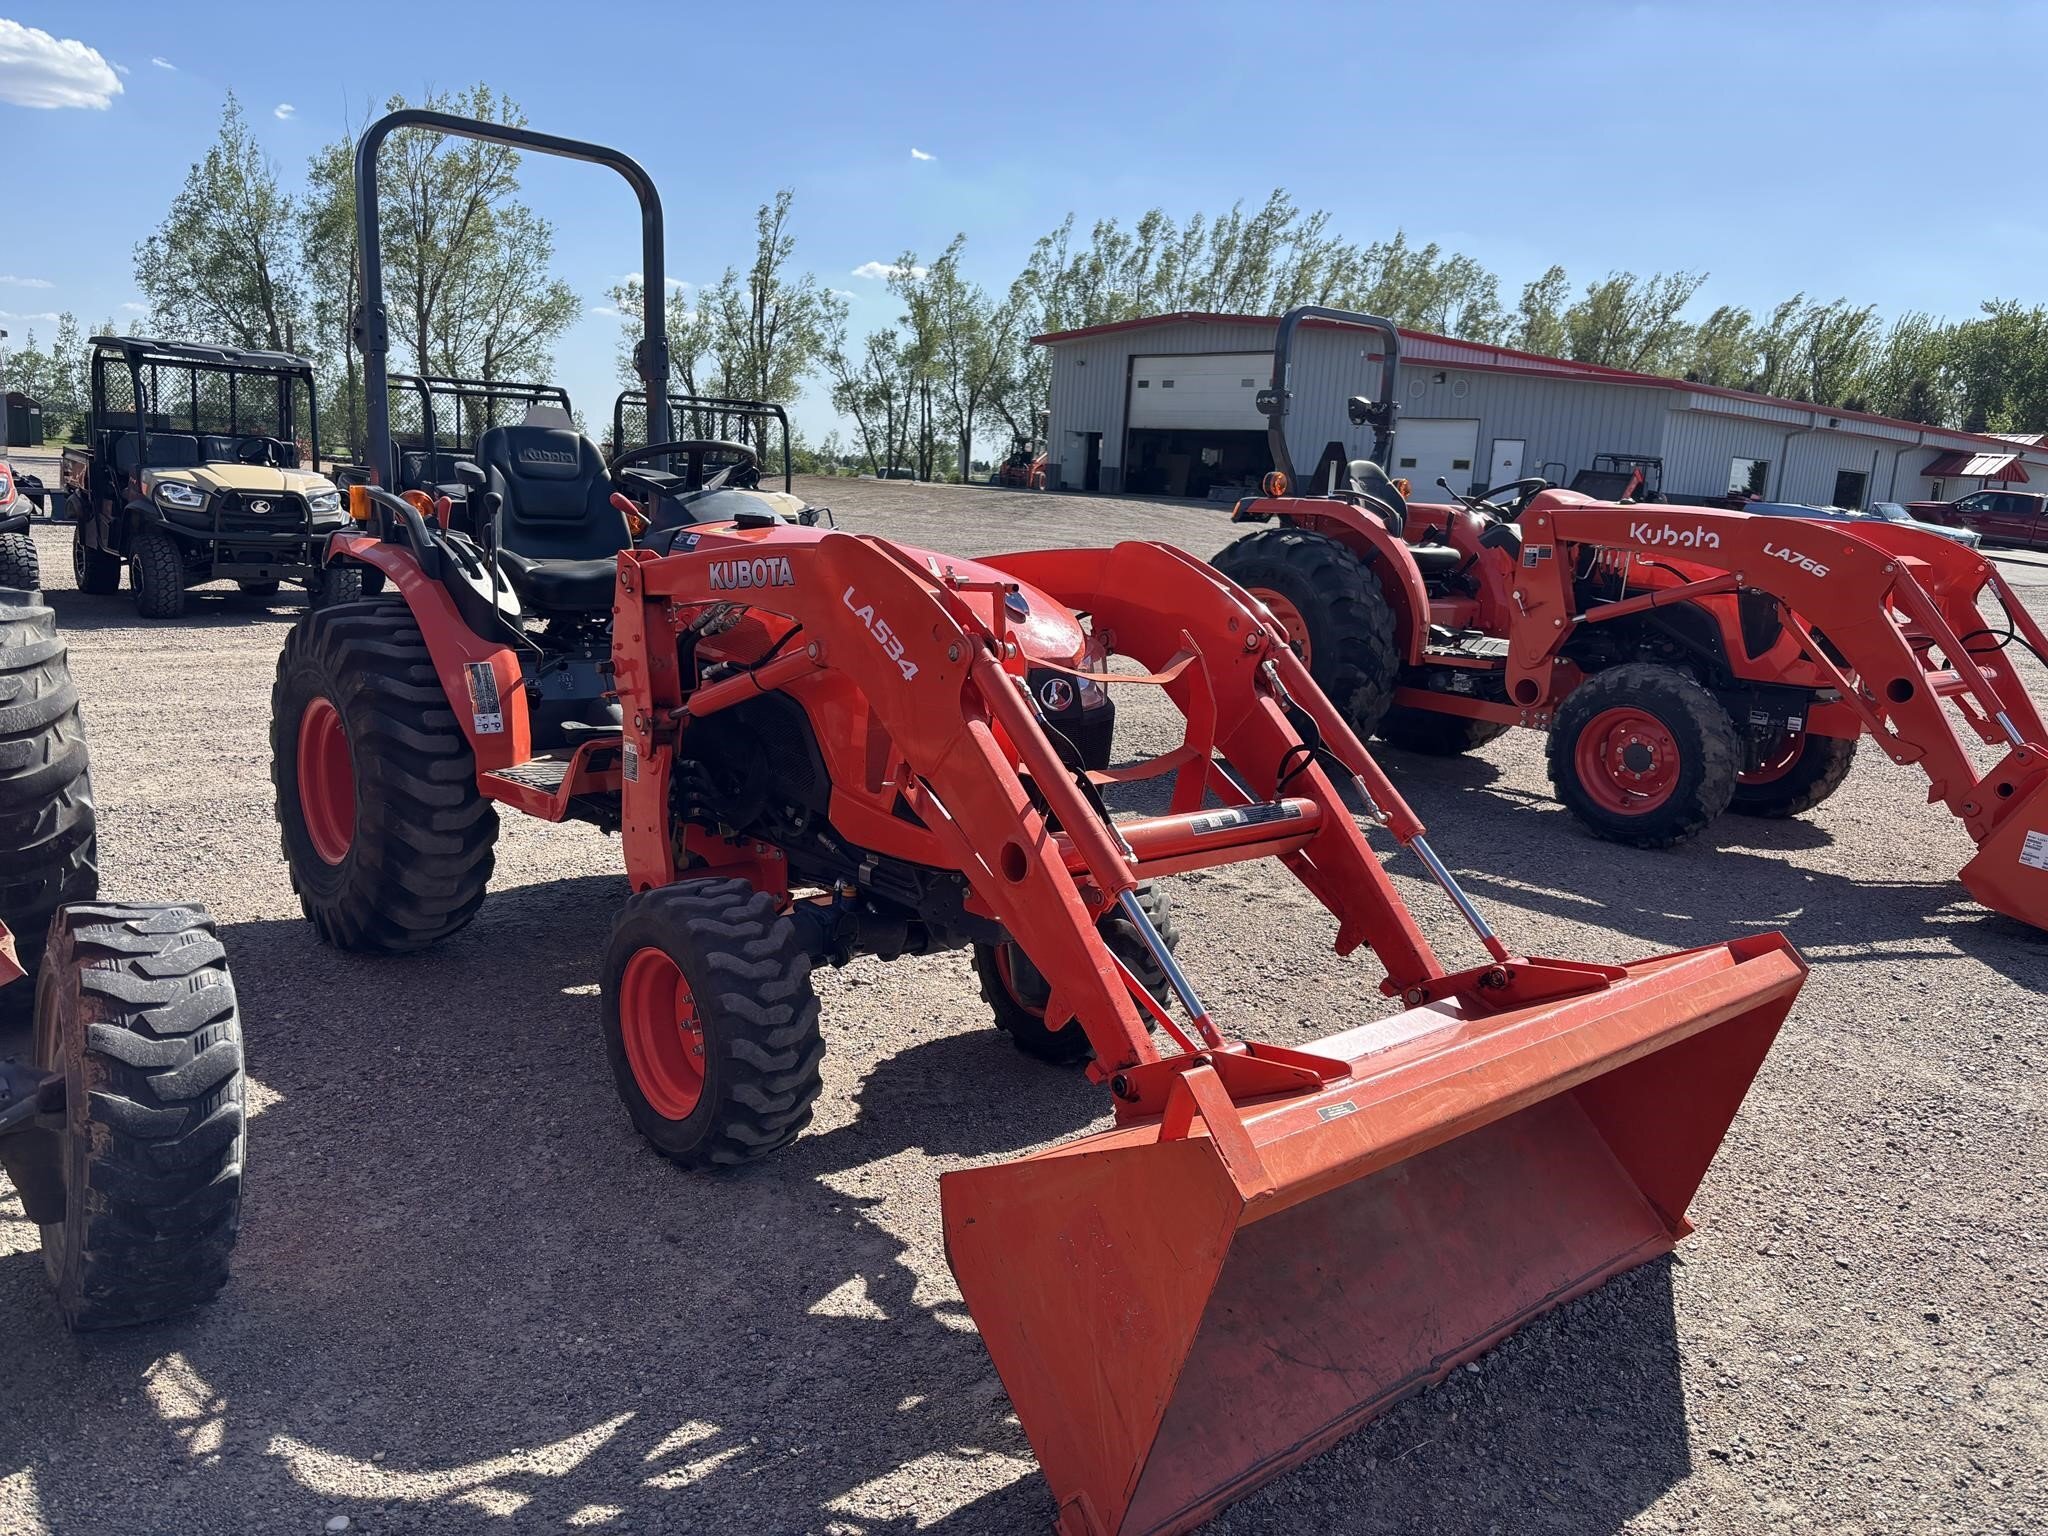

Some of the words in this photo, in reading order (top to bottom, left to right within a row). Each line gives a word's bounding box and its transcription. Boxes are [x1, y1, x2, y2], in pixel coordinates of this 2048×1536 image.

[1630, 522, 1720, 548] Kubota
[709, 556, 796, 591] KUBOTA
[1763, 542, 1831, 578] LA766
[843, 585, 919, 682] LA534
